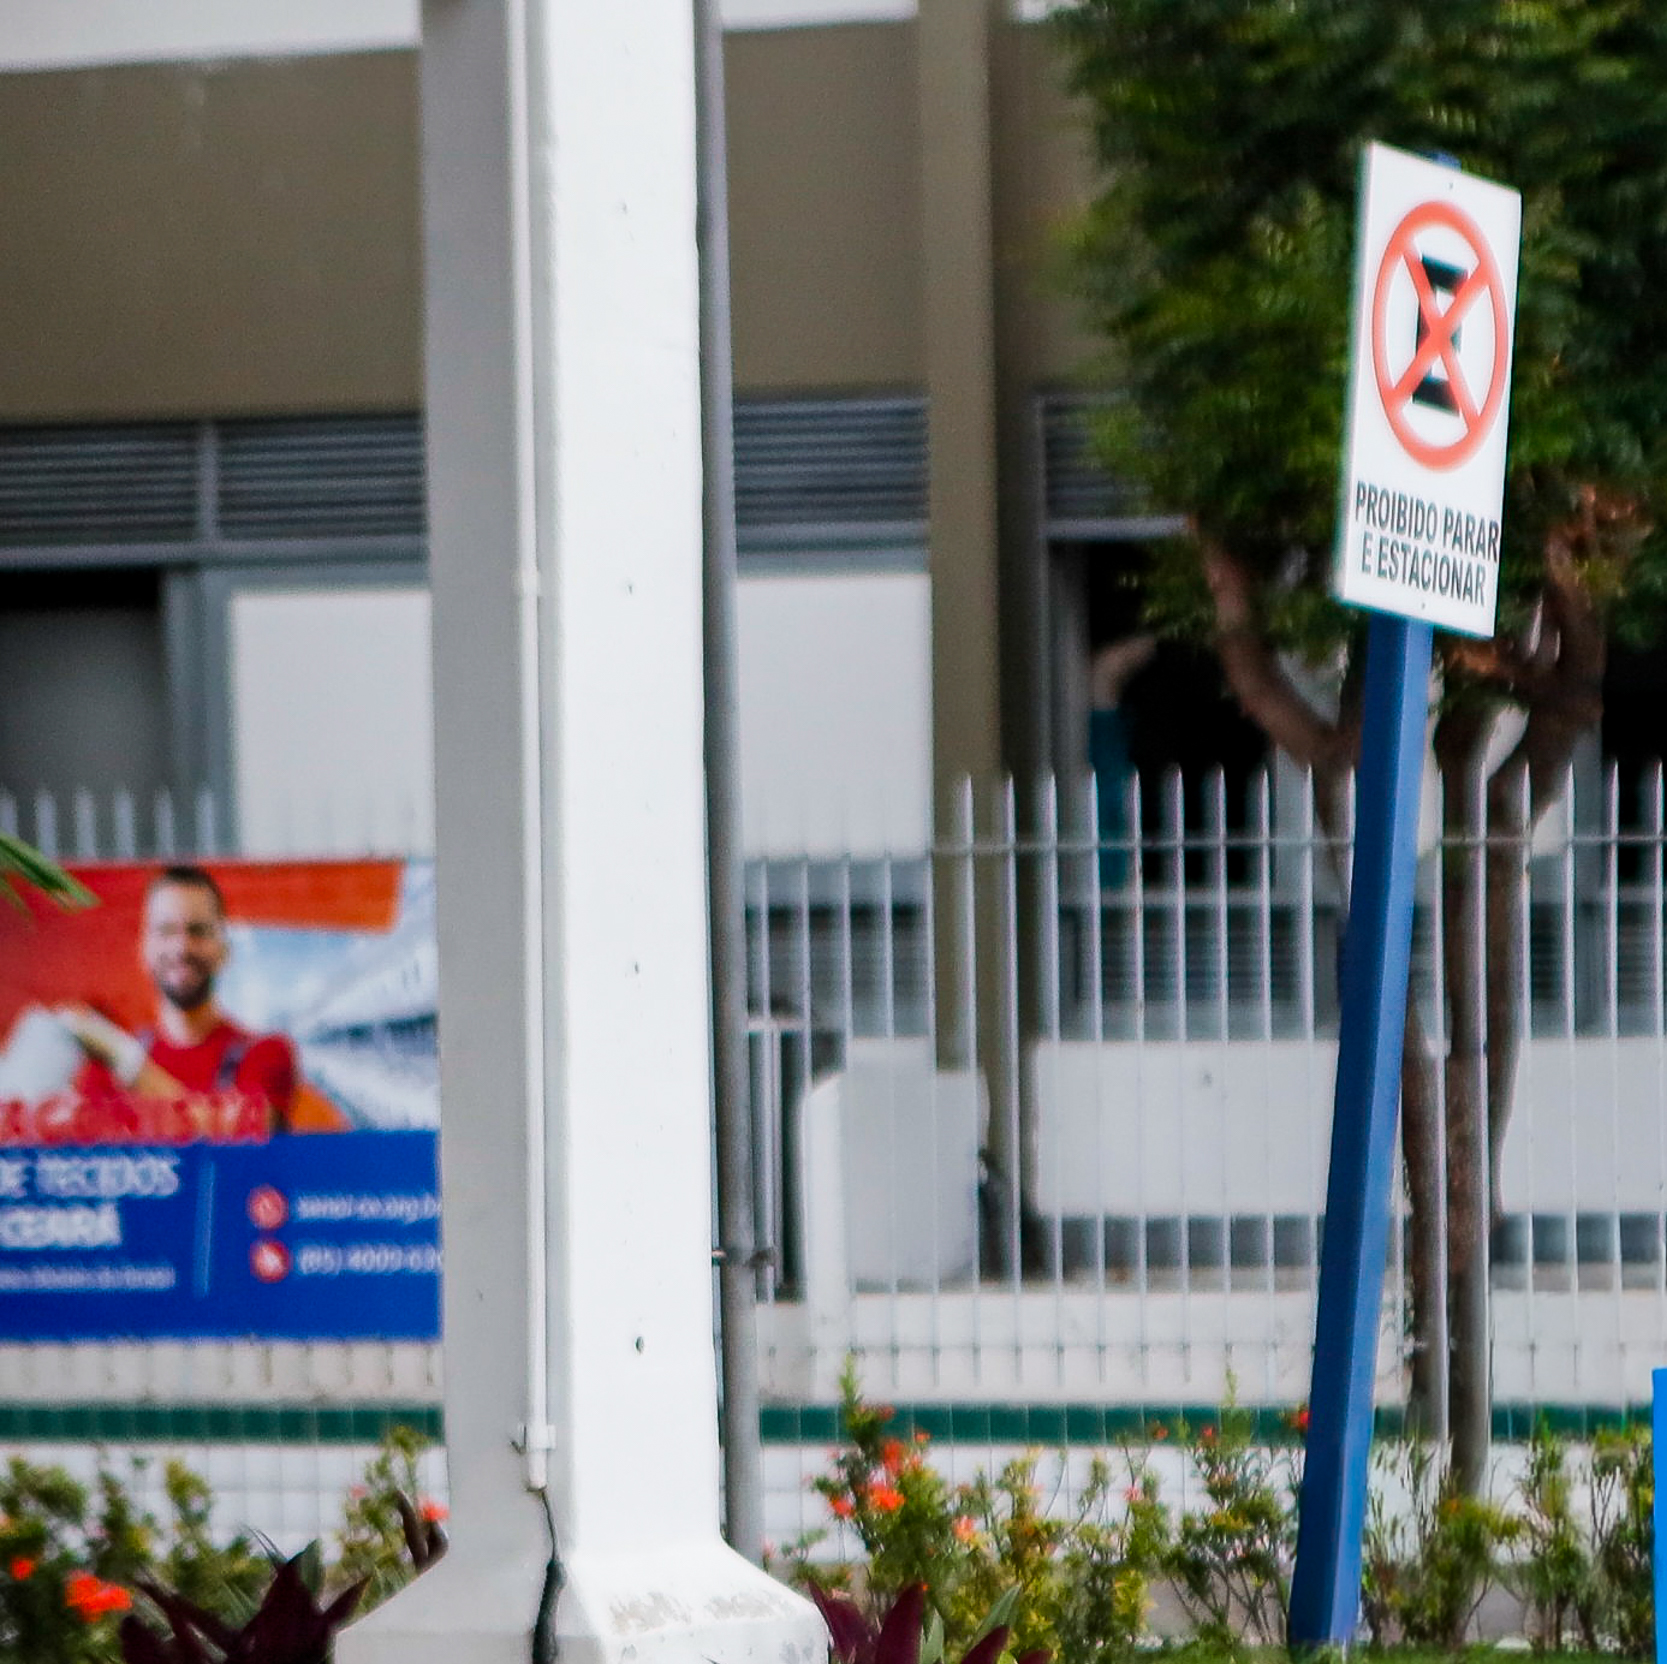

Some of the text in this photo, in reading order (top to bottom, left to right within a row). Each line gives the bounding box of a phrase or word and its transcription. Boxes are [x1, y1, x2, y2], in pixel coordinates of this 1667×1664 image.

[1355, 480, 1499, 562] PROIBIDO PARAR
[1361, 531, 1486, 607] E ESTACIONAR
[37, 1154, 181, 1197] TECIDOS
